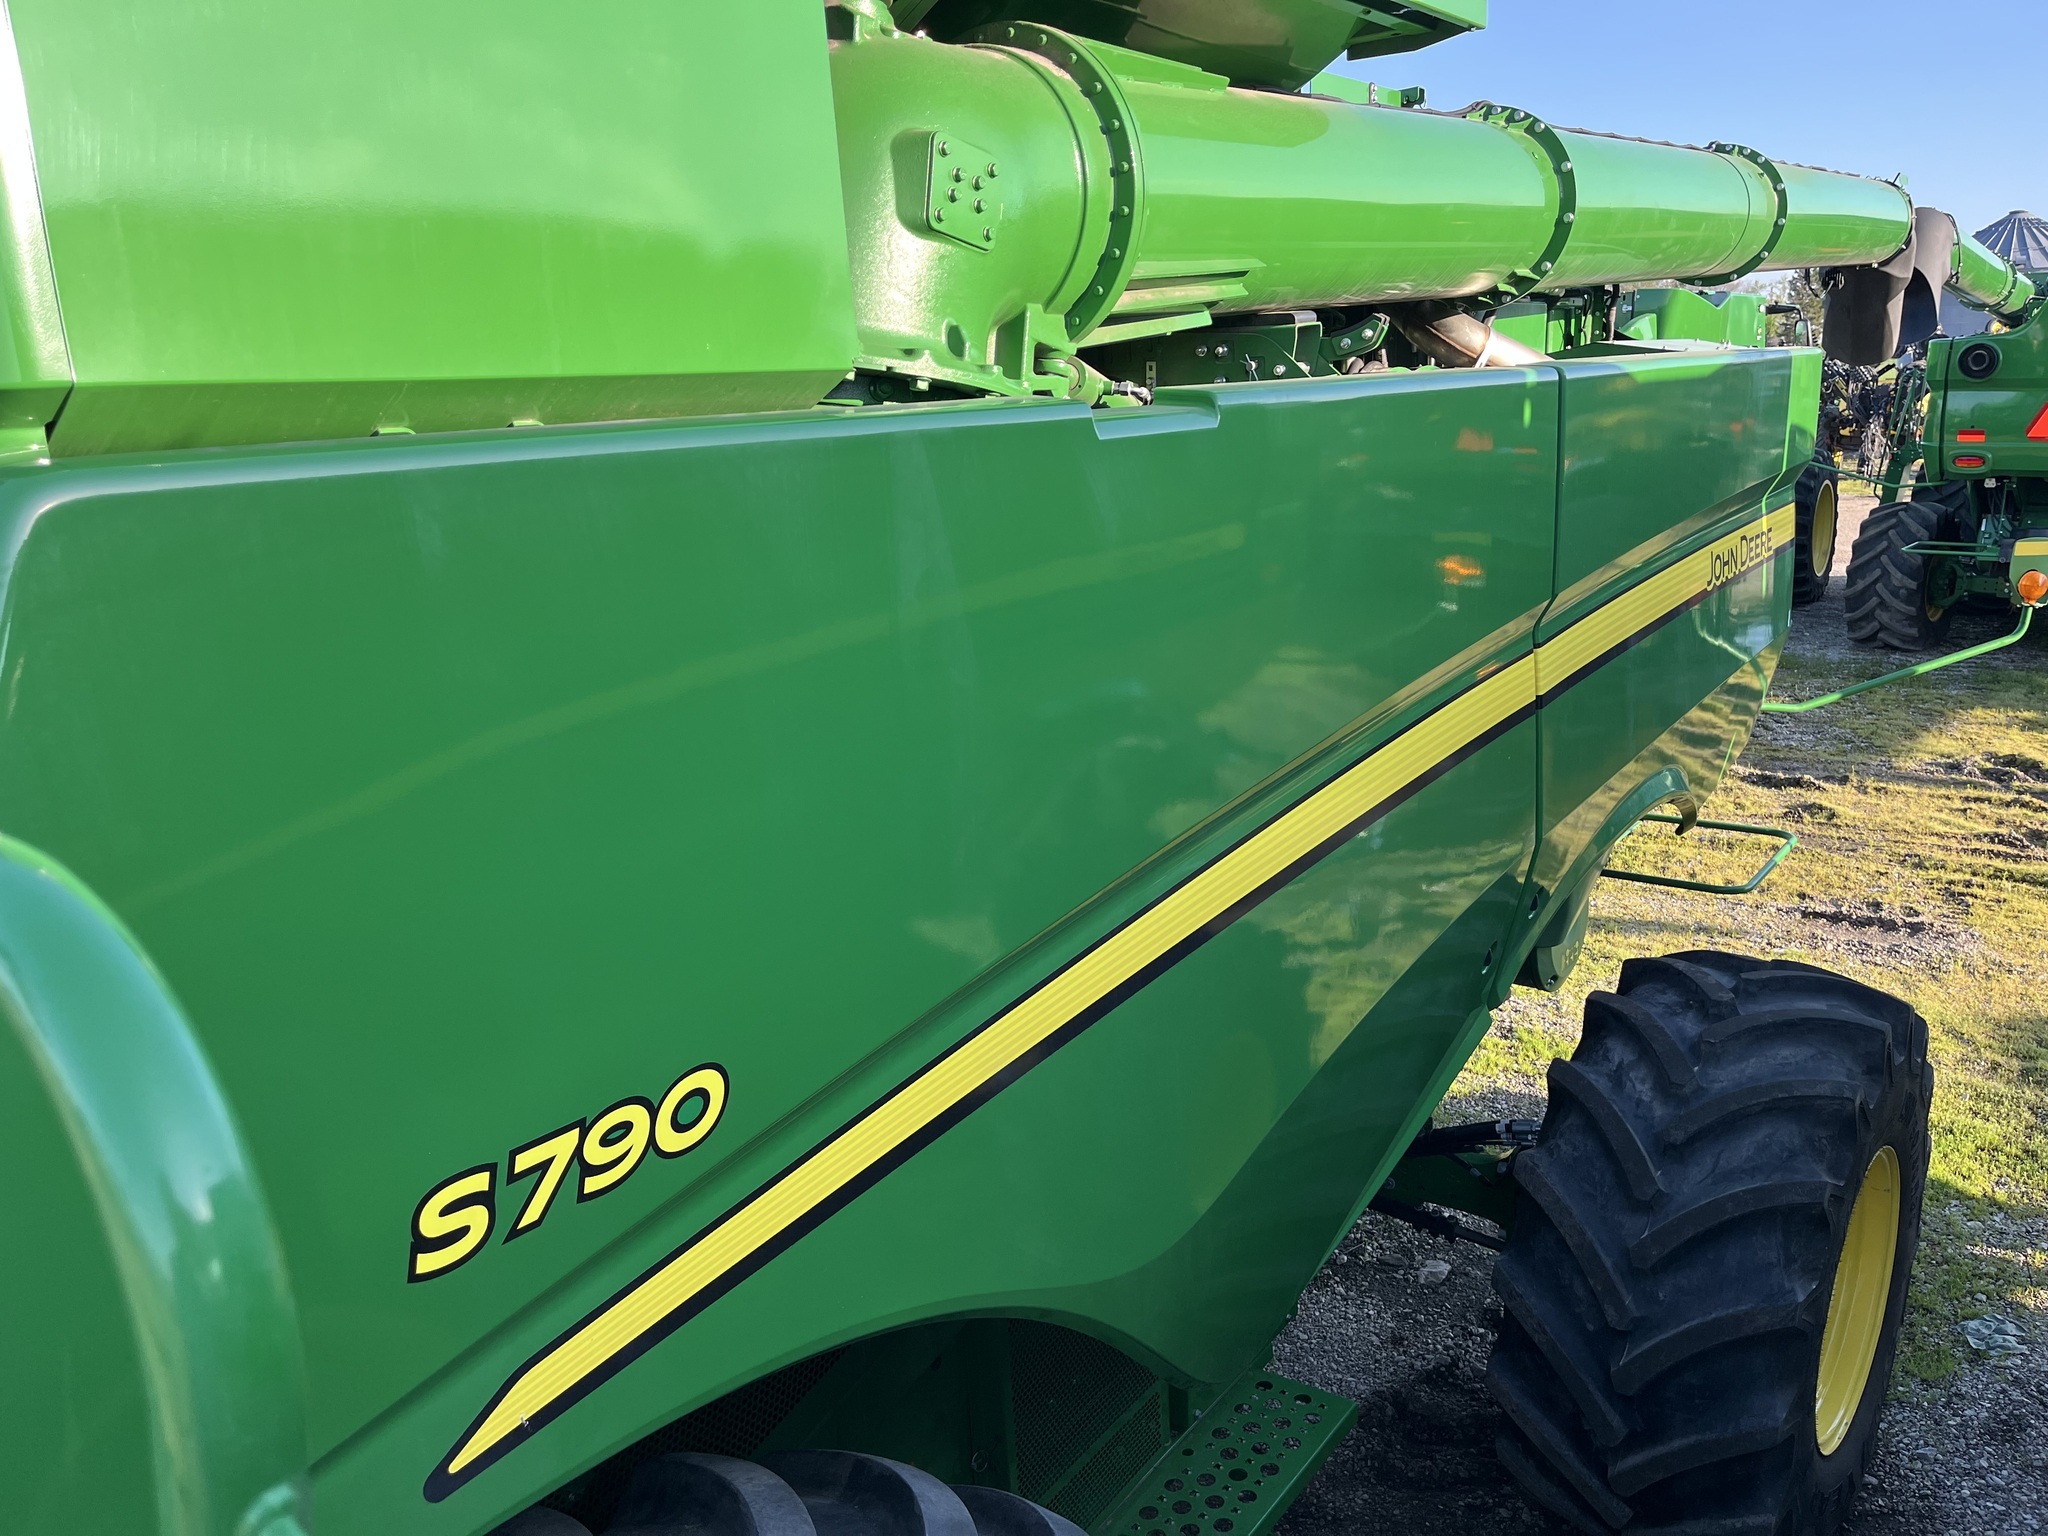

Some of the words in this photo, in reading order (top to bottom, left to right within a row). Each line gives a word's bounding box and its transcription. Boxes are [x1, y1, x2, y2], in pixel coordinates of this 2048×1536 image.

[1706, 545, 1738, 588] JOHN
[1740, 527, 1773, 568] DEERE
[407, 1062, 730, 1284] S790
